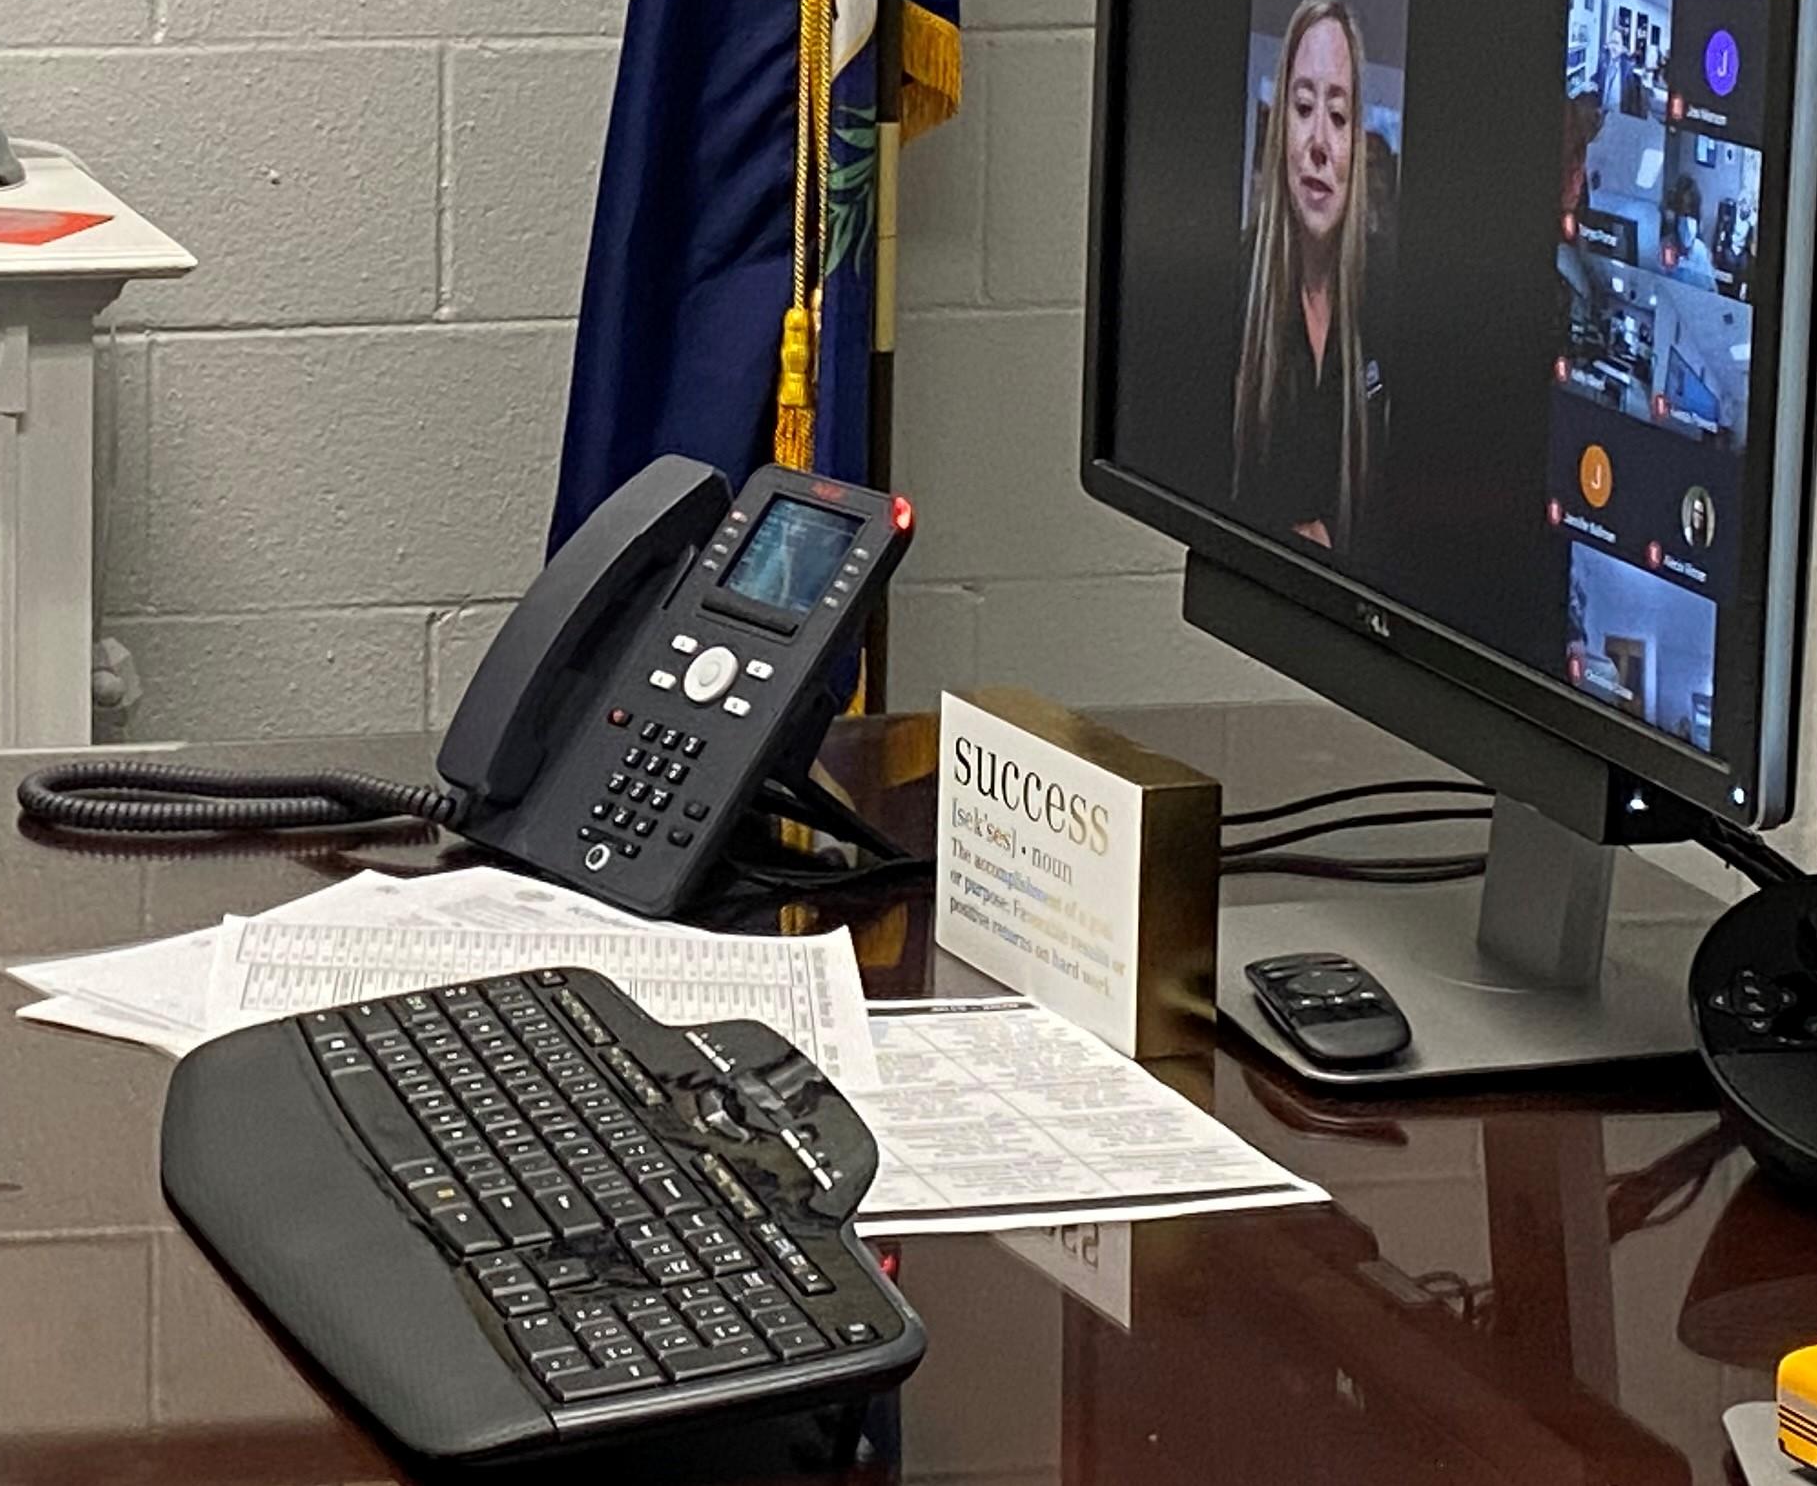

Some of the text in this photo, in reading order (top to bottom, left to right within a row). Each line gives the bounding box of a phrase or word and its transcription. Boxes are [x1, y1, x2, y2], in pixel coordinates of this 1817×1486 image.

[1716, 49, 1729, 77] J
[1590, 464, 1602, 490] J
[953, 732, 1109, 859] success
[951, 836, 971, 865] The
[1031, 844, 1072, 886] noun
[949, 893, 989, 932] positive
[992, 918, 1032, 955] returns
[1035, 943, 1049, 964] on
[1052, 948, 1079, 980] hard
[950, 868, 961, 887] or
[1112, 954, 1125, 978] or
